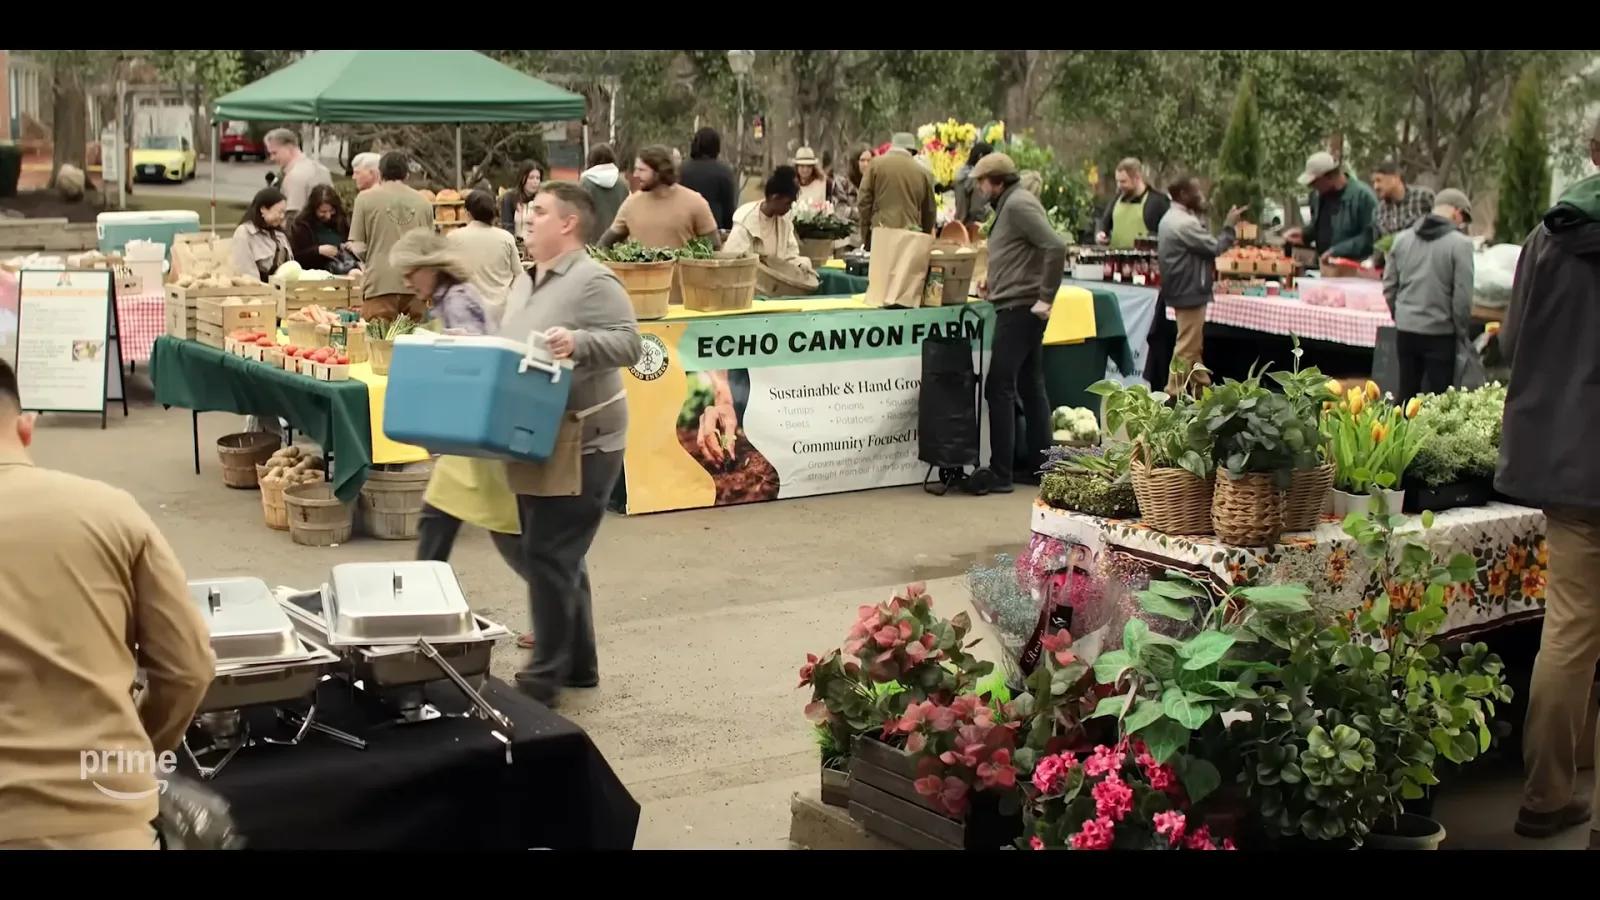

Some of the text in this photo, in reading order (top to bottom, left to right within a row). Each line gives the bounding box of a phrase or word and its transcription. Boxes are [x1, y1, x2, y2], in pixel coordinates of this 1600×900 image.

[698, 318, 984, 358] ECHO CANYON FARM
[769, 382, 840, 400] Sustainable
[843, 382, 855, 395] &
[858, 378, 892, 394] Hand
[783, 405, 815, 416] Turnips
[834, 401, 865, 412] Onions
[785, 420, 811, 430] Beets
[836, 414, 875, 425] Potatoes
[792, 436, 866, 455] Community
[868, 429, 912, 448] Focused
[808, 460, 835, 470] Grown
[807, 470, 837, 481] straight
